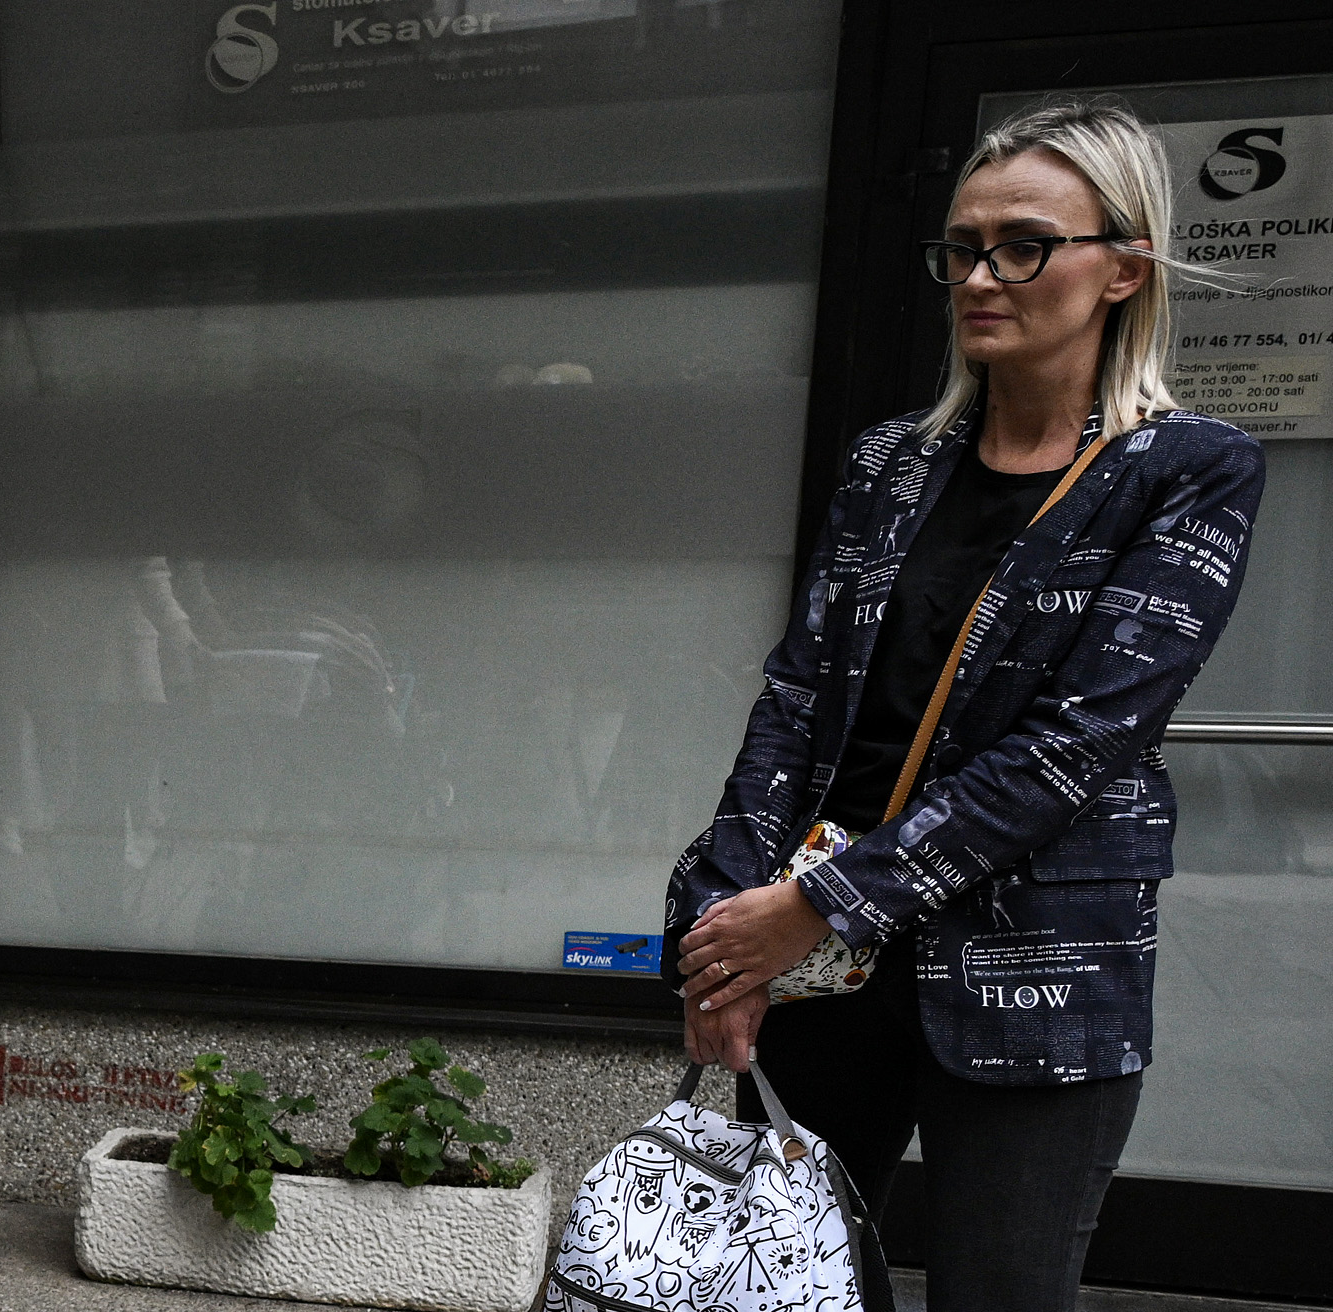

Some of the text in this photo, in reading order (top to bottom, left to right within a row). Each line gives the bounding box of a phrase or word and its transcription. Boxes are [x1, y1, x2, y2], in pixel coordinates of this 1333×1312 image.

[333, 12, 501, 48] Ksaver
[1261, 217, 1333, 237] POLIK
[1186, 243, 1276, 262] KSAVER
[1182, 335, 1205, 348] 01/
[1209, 335, 1228, 347] 46
[1234, 334, 1251, 346] 77
[1221, 374, 1246, 385] 9:00
[1262, 373, 1294, 384] 17:00
[1298, 372, 1319, 383] sati
[1202, 389, 1233, 399] 13:00
[1247, 387, 1280, 398] 20:00
[1284, 386, 1305, 397] sati
[1195, 402, 1279, 415] DOGOVORU
[1155, 533, 1174, 545] we
[1174, 540, 1196, 552] are
[1196, 548, 1214, 560] all
[1211, 556, 1231, 575] made
[1189, 559, 1229, 588] of STARS
[1040, 768, 1054, 781] and
[1052, 778, 1061, 787] to
[1059, 784, 1071, 795] be
[1041, 757, 1054, 769] are
[1052, 766, 1068, 781] born
[1066, 778, 1076, 788] to
[895, 846, 910, 861] we
[908, 860, 924, 876] are
[922, 875, 938, 888] all
[912, 882, 926, 893] of
[980, 983, 1073, 1009] FLOW
